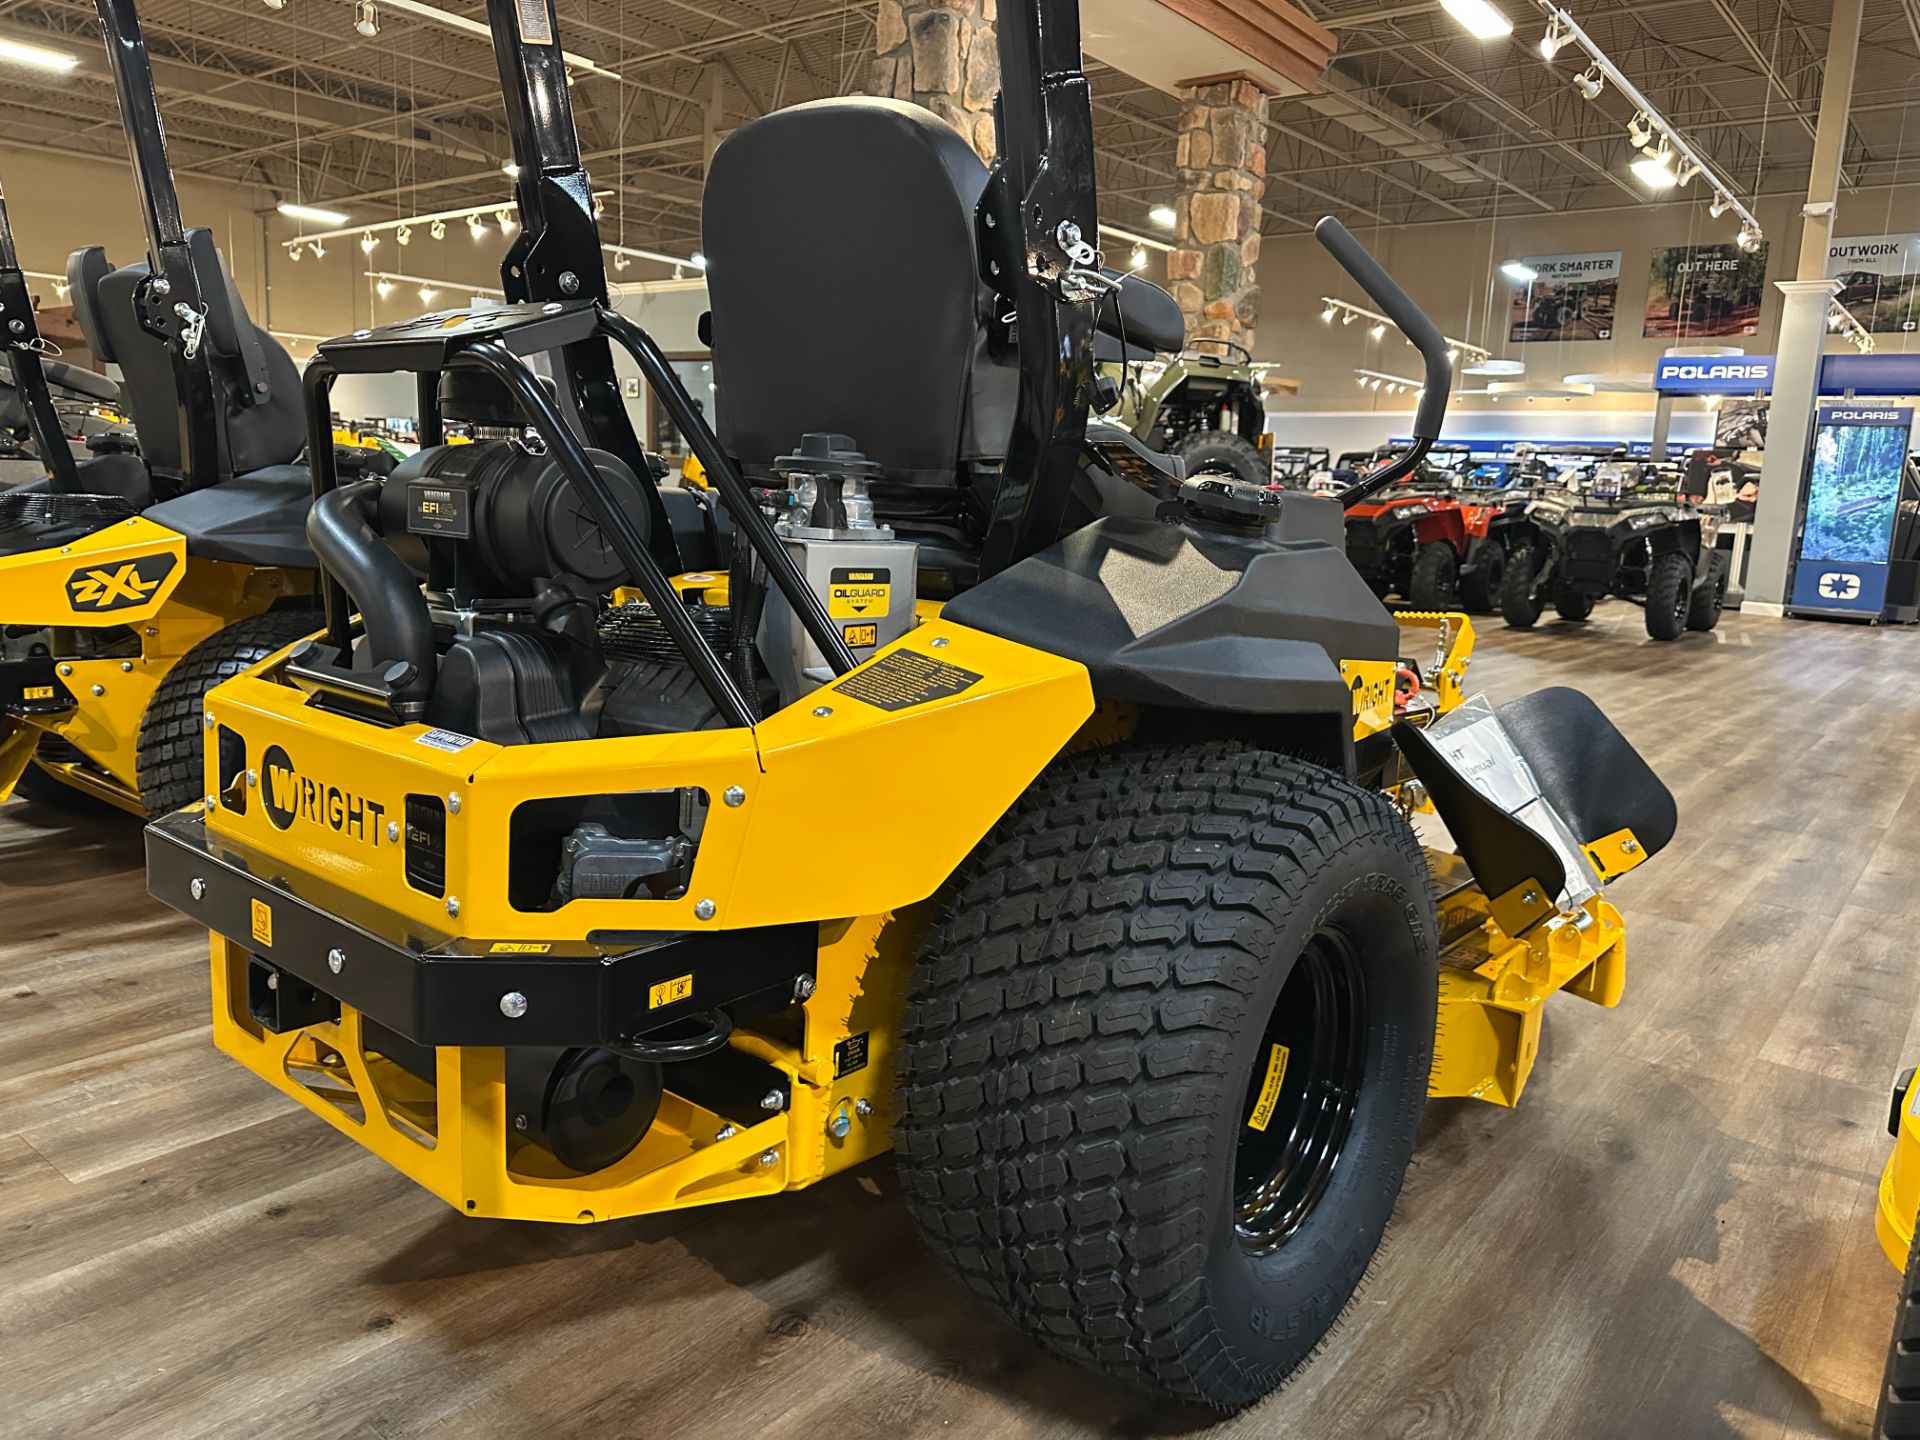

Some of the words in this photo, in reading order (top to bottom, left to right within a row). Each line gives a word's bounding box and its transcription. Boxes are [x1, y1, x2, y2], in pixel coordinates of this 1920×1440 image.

[1829, 243, 1899, 257] OUTWORK
[1559, 259, 1614, 273] SMARTER
[1677, 261, 1703, 273] OUT
[1705, 260, 1739, 271] HERE
[1661, 365, 1769, 379] POLARIS
[1831, 411, 1900, 420] POLARIS
[422, 501, 439, 514] EFI
[834, 589, 886, 598] OILGUARD
[261, 746, 385, 848] WRIGHT
